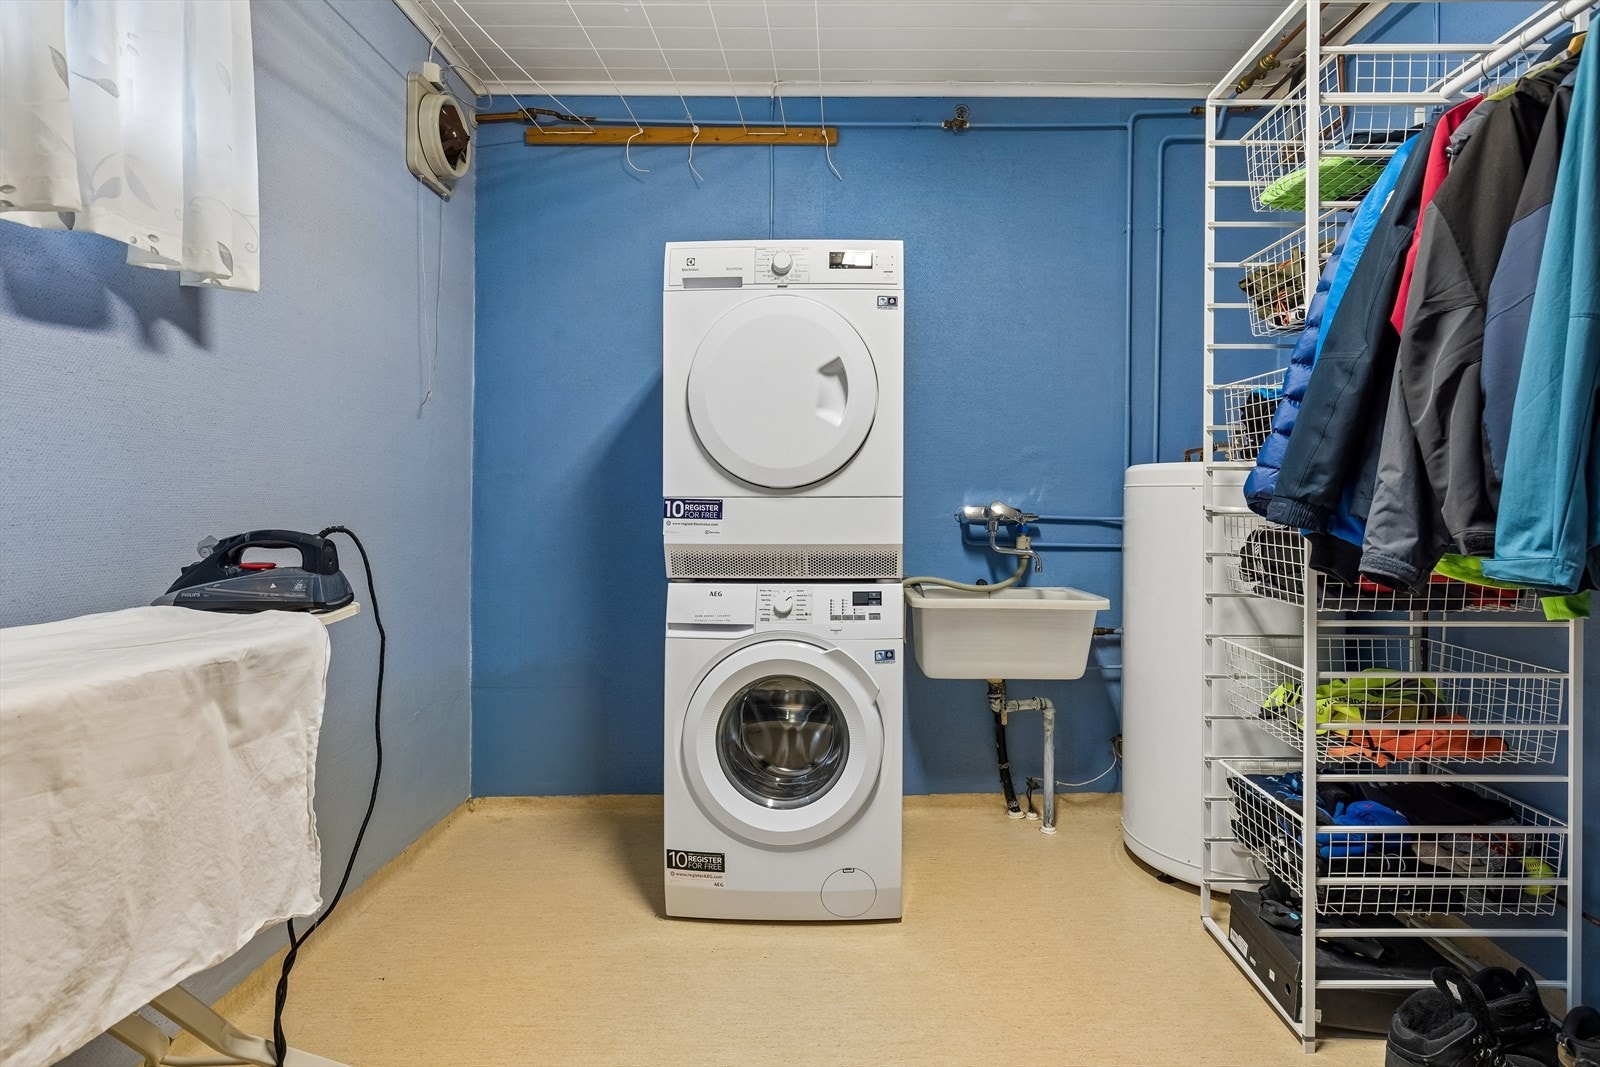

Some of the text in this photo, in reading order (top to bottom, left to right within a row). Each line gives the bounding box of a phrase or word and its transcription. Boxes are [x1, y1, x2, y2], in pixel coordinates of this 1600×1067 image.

[665, 500, 684, 518] 10
[701, 511, 718, 519] FREE
[668, 851, 688, 868] 10
[688, 855, 723, 864] REGISTER
